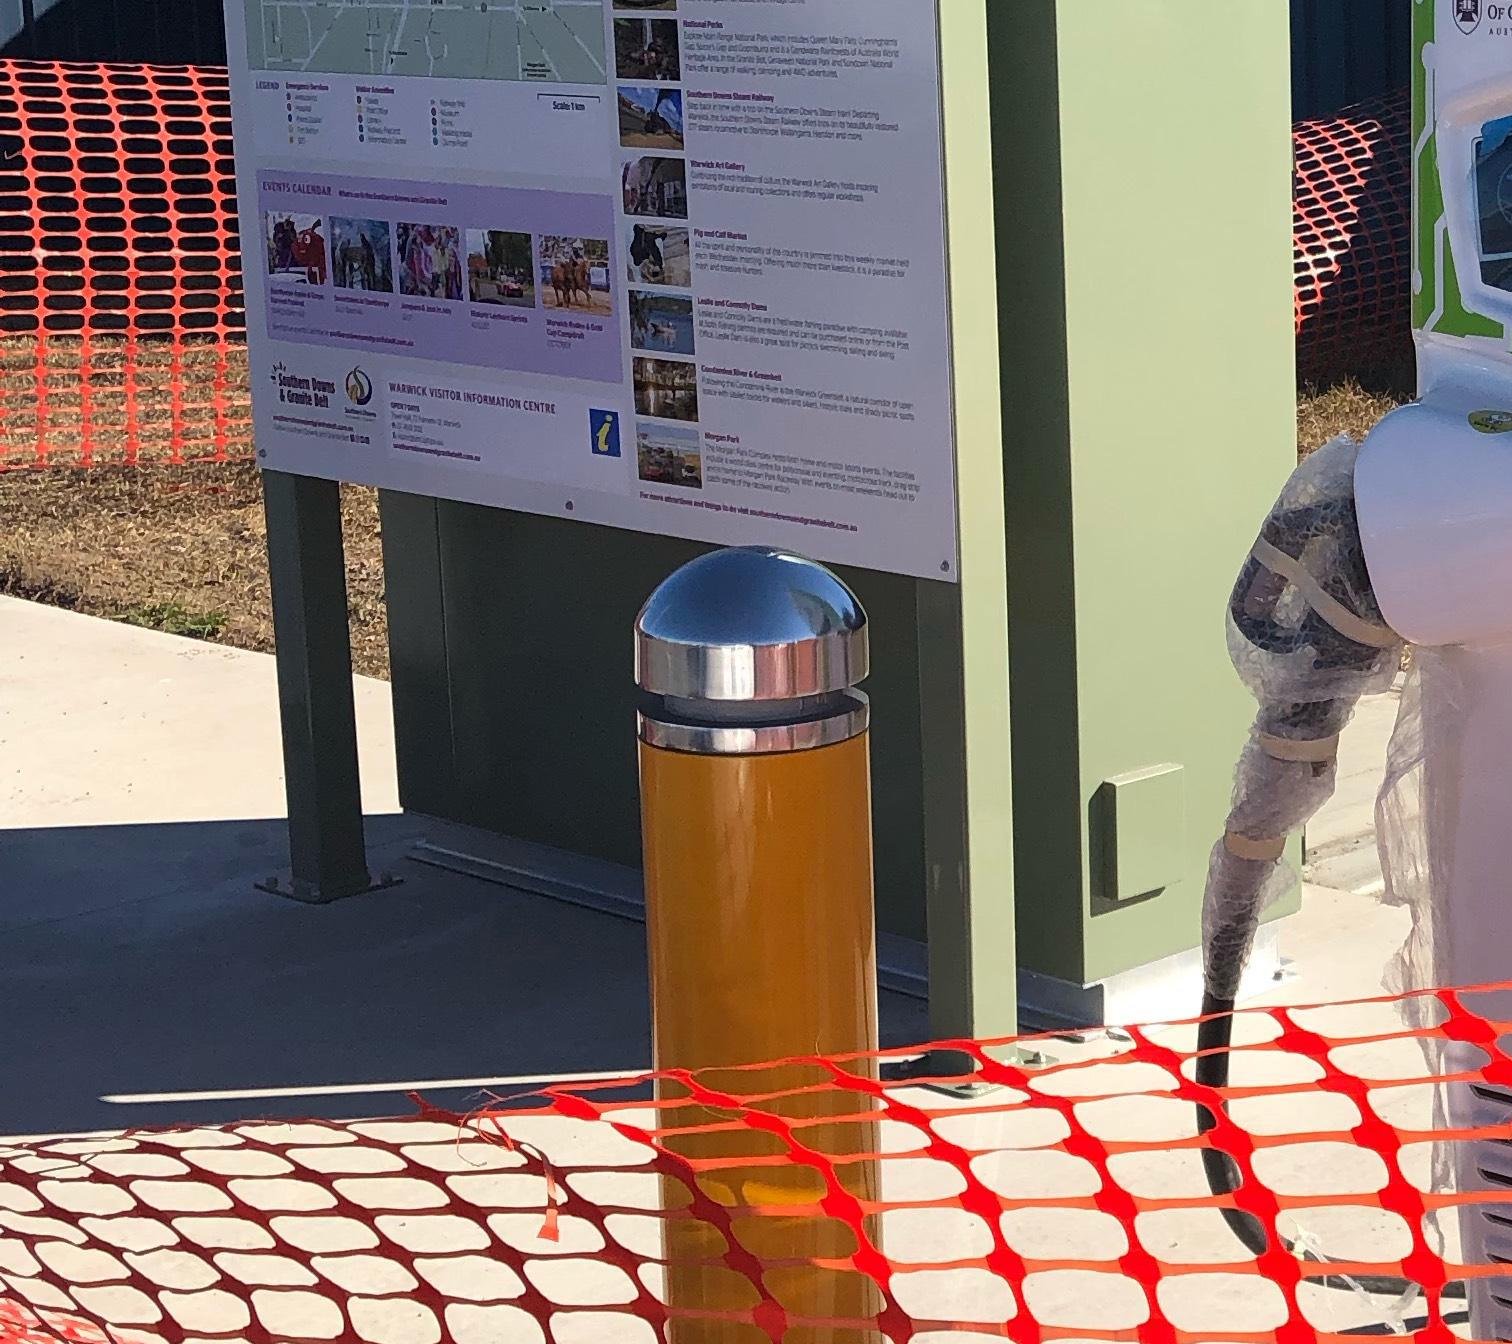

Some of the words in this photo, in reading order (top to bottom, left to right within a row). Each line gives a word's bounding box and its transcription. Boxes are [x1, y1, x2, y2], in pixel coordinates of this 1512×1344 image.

[263, 182, 290, 192] EVENTS
[292, 184, 332, 195] CALENDAR
[278, 373, 310, 390] Southern
[311, 378, 335, 394] Downs
[287, 390, 312, 406] Granite
[314, 393, 329, 408] Belt
[388, 383, 426, 396] WARWICK
[429, 389, 460, 400] VISITOR
[463, 394, 520, 408] INFORMATION
[523, 401, 555, 413] CENTRE
